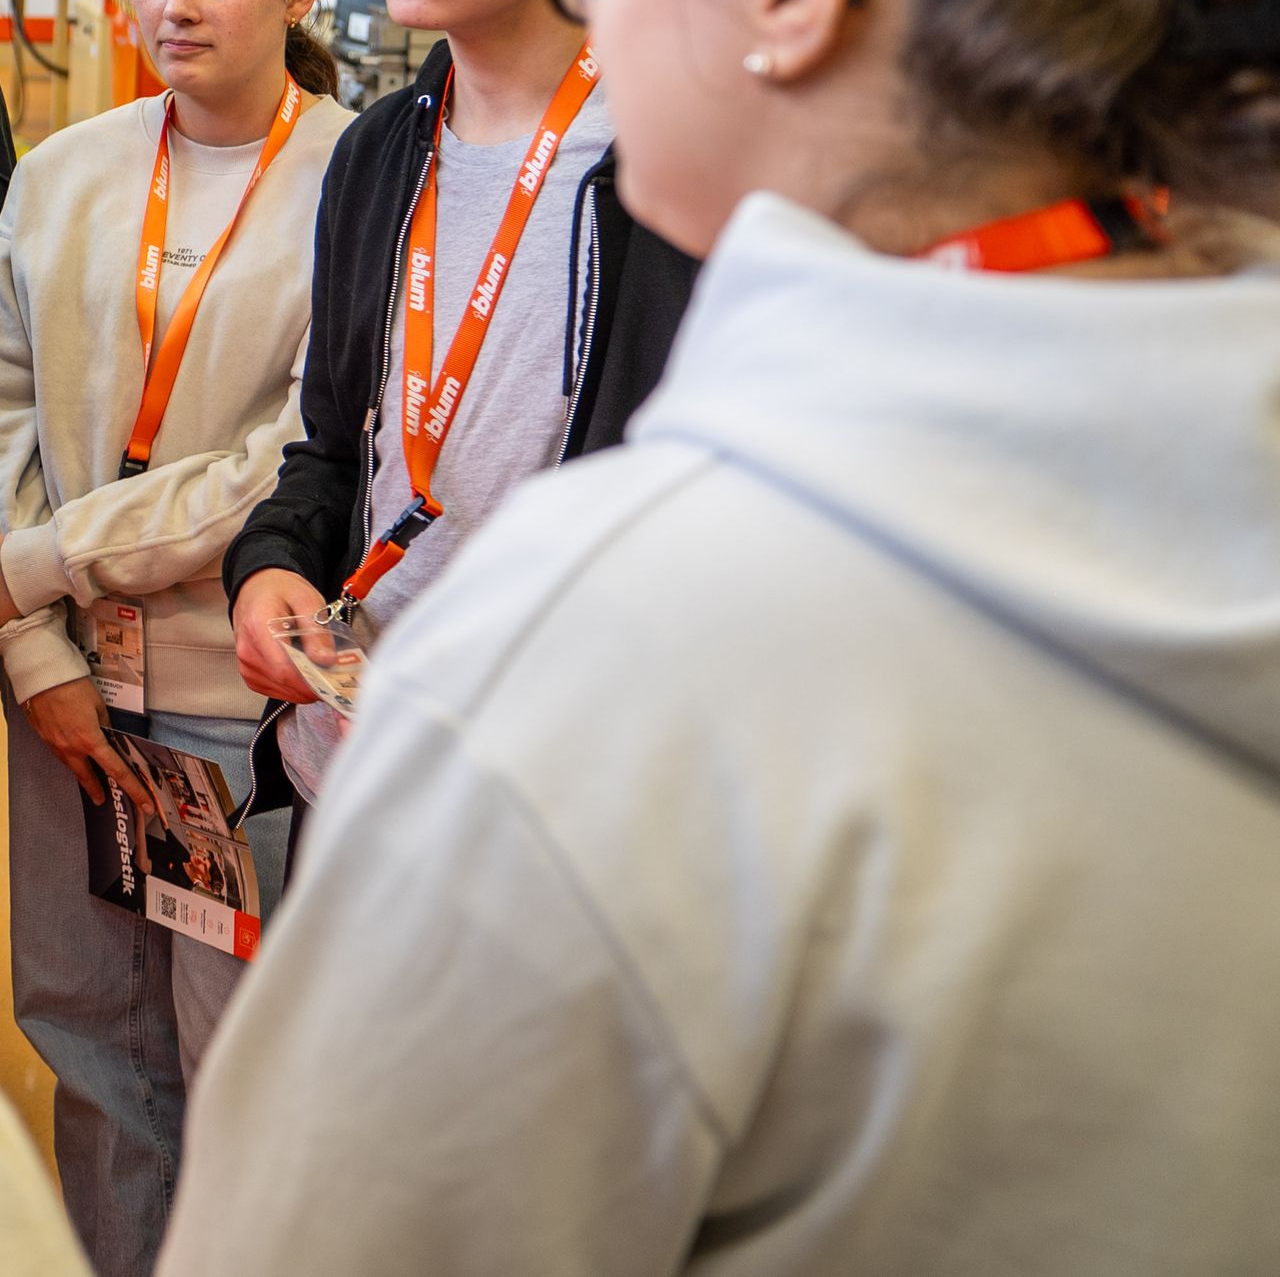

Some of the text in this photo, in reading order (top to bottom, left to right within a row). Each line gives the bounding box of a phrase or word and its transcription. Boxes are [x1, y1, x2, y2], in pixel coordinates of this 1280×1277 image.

[281, 81, 301, 123] blum
[153, 155, 169, 201] blum
[520, 129, 558, 192] blum
[140, 244, 160, 290] blum
[162, 251, 199, 262] EVENTY
[410, 252, 431, 311] blum
[472, 252, 507, 317] blum
[406, 378, 427, 436] blum
[424, 376, 461, 441] blum
